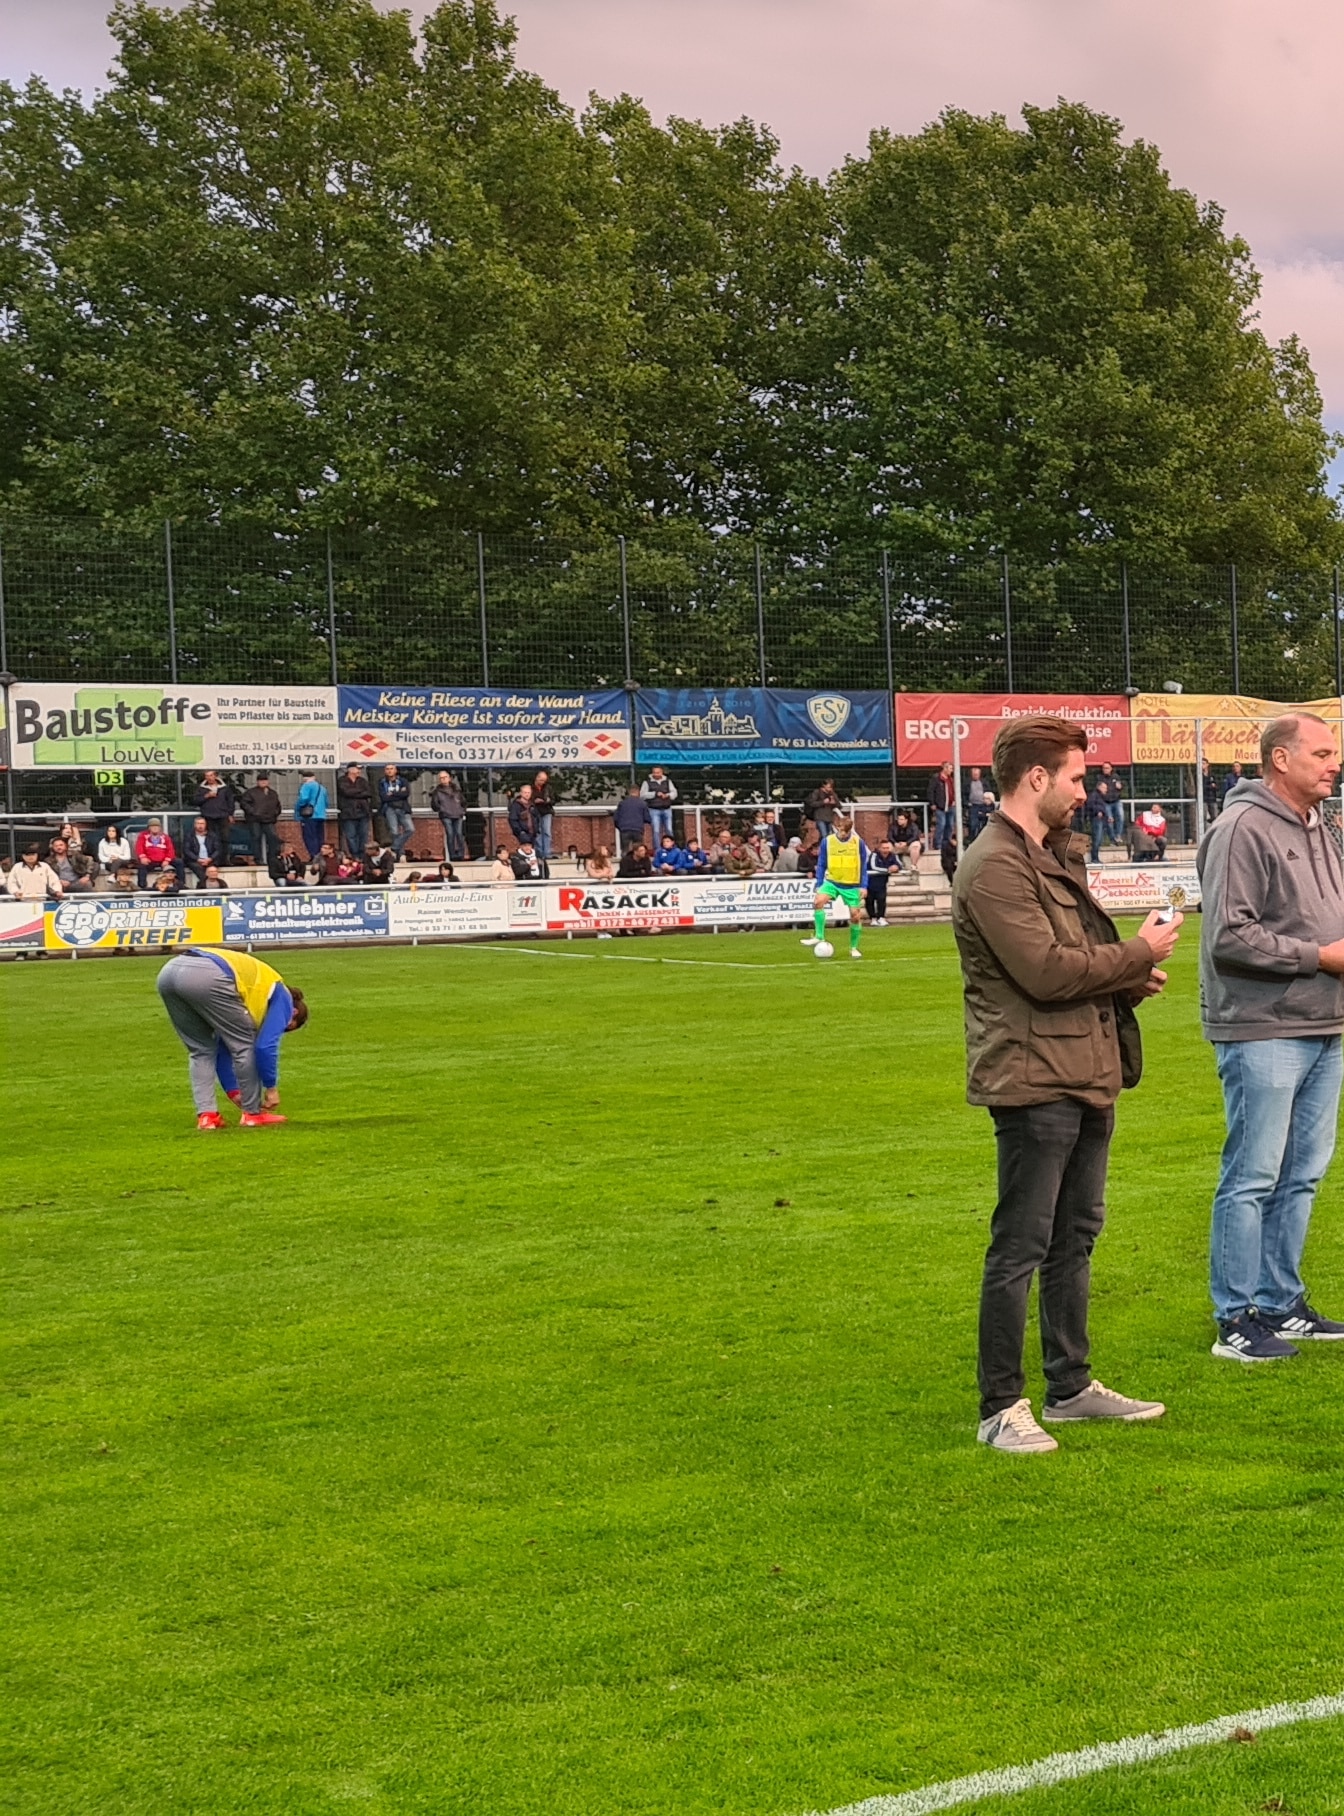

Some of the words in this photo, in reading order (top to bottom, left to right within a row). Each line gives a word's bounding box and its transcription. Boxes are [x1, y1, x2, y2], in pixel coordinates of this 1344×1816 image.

[217, 698, 229, 707] Ihr
[233, 698, 265, 707] Partner
[269, 698, 282, 707] für
[284, 698, 326, 708] Baustoffe
[378, 692, 426, 708] Keine
[430, 692, 476, 708] Fliese
[479, 697, 502, 708] an
[506, 693, 533, 708] der
[538, 694, 584, 708] Wand
[1136, 697, 1169, 707] HOTEL
[15, 697, 212, 744] Baustoffe
[217, 712, 237, 720] vom
[240, 711, 274, 720] Pflaster
[277, 712, 290, 720] bis
[293, 712, 311, 720] zum
[314, 711, 334, 720] Dach
[344, 709, 408, 724] Meister
[412, 709, 469, 727] Körtge
[473, 710, 493, 724] ist
[497, 710, 545, 726] sofort
[549, 713, 576, 727] zur
[579, 711, 626, 725] Hand.
[904, 719, 970, 740] ERGO
[396, 731, 530, 746] Fliesenlegermeister
[533, 732, 579, 746] Körtge
[772, 737, 791, 747] FSV
[793, 738, 806, 747] 63
[808, 738, 869, 748] Luckenwalde
[101, 746, 175, 763] LouVet
[219, 755, 239, 765] Tel.
[242, 755, 276, 765] 03371
[287, 755, 301, 765] 59
[304, 755, 318, 765] 73
[321, 755, 335, 765] 40
[396, 747, 454, 760] Telefon
[516, 747, 533, 760] 64
[539, 747, 557, 760] 29
[561, 747, 579, 760] 99
[1136, 748, 1175, 761] (03371)
[96, 771, 122, 784] D3
[133, 898, 217, 909] Seelenbinder
[393, 891, 494, 905] Auto-Einmal-Eins
[559, 888, 671, 918] RASACK
[254, 898, 357, 917] Schliebner
[695, 905, 728, 914] Verkauf
[734, 904, 781, 913] Vermietung
[57, 909, 186, 931] SPORTLER
[248, 915, 365, 930] Unterhaltungselektronik
[563, 918, 595, 929] mobil
[115, 927, 193, 945] TREFF
